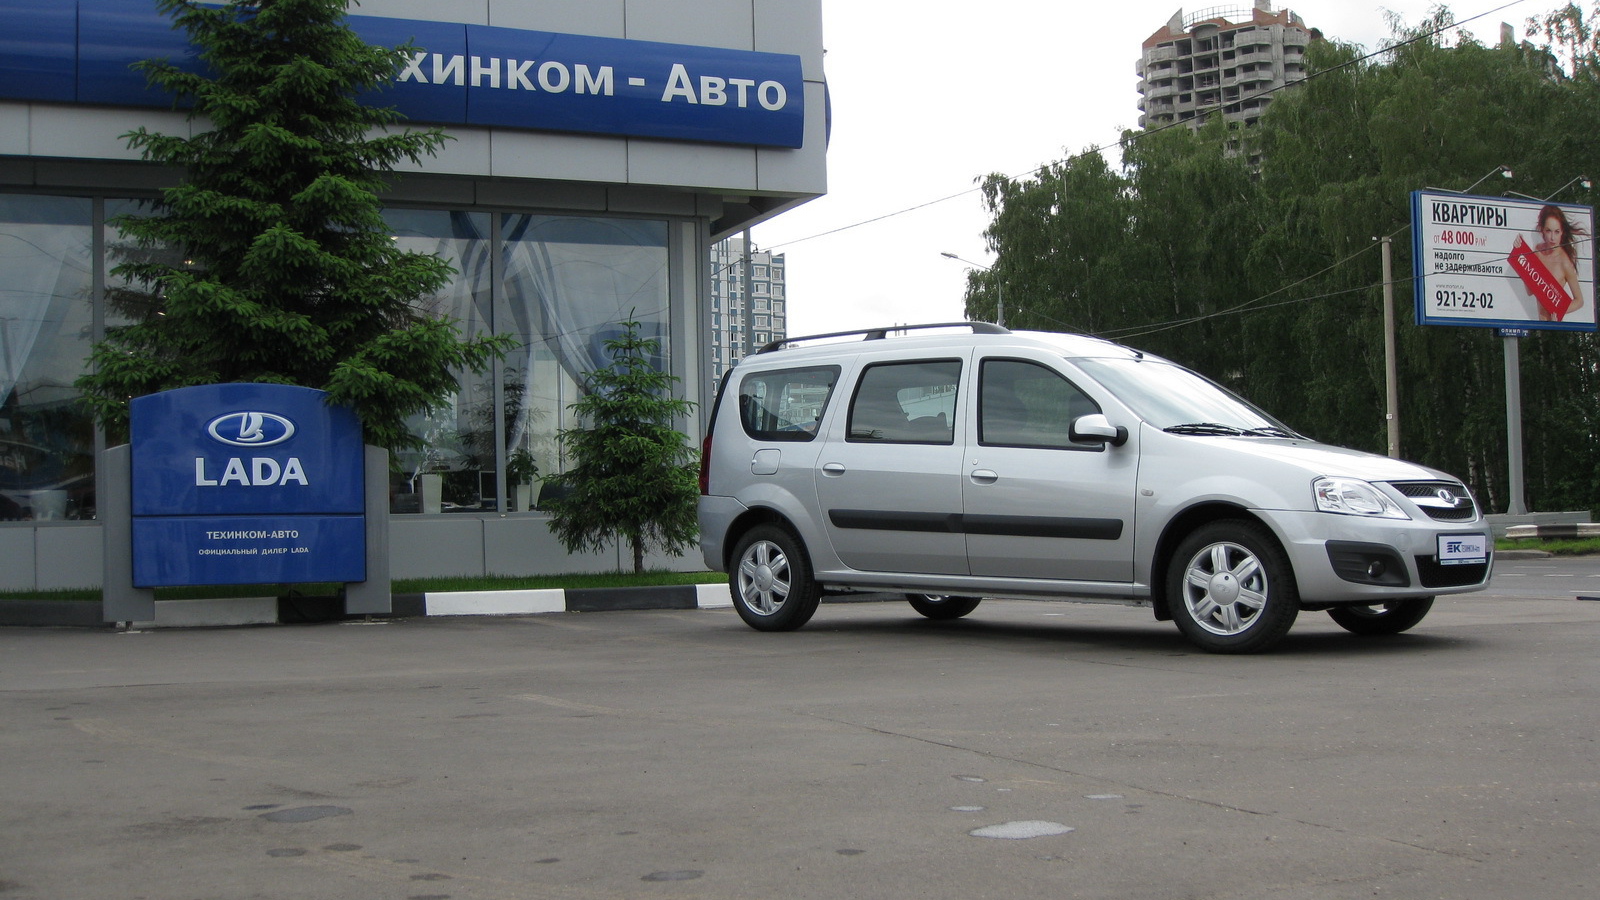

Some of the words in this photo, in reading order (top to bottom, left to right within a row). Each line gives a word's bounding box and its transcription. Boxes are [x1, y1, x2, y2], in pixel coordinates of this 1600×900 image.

[374, 49, 614, 96] ХИНКОМ
[1432, 202, 1507, 227] КВАРТИРЫ
[1441, 230, 1453, 244] 48
[1456, 231, 1474, 246] 000
[1434, 252, 1465, 261] надолго
[1434, 262, 1444, 270] не
[1445, 262, 1503, 274] задерживаются
[1525, 263, 1561, 308] МОРТОН
[1436, 290, 1494, 309] 921-22-02
[195, 457, 309, 486] LADA
[206, 530, 299, 540] ТЕХИНКОМ-АВТО
[198, 547, 258, 556] ОФИЦИАЛЬНЫЙ
[261, 547, 288, 556] ДИЛЕР
